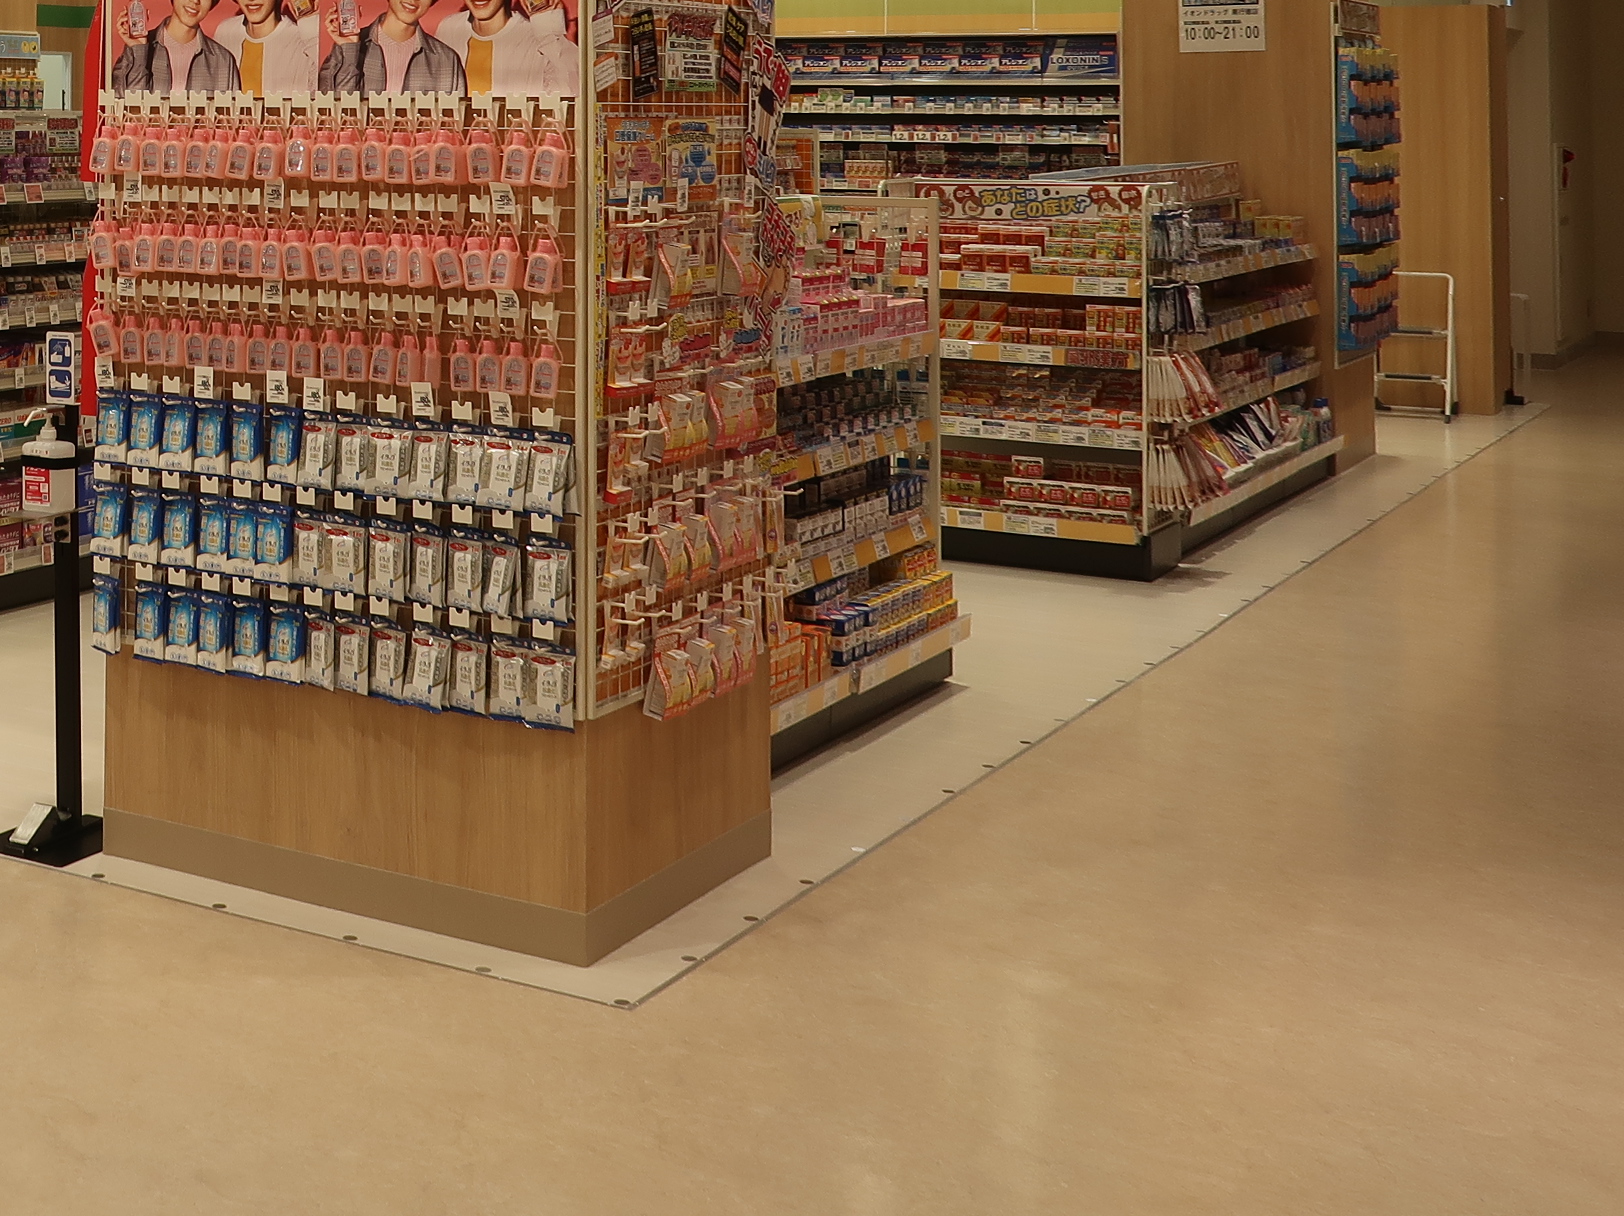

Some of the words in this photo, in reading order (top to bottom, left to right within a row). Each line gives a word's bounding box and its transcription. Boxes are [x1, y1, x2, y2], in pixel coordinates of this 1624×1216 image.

[1050, 55, 1100, 65] LOXONIN
[1100, 56, 1109, 64] S
[979, 187, 1038, 206] あなたは
